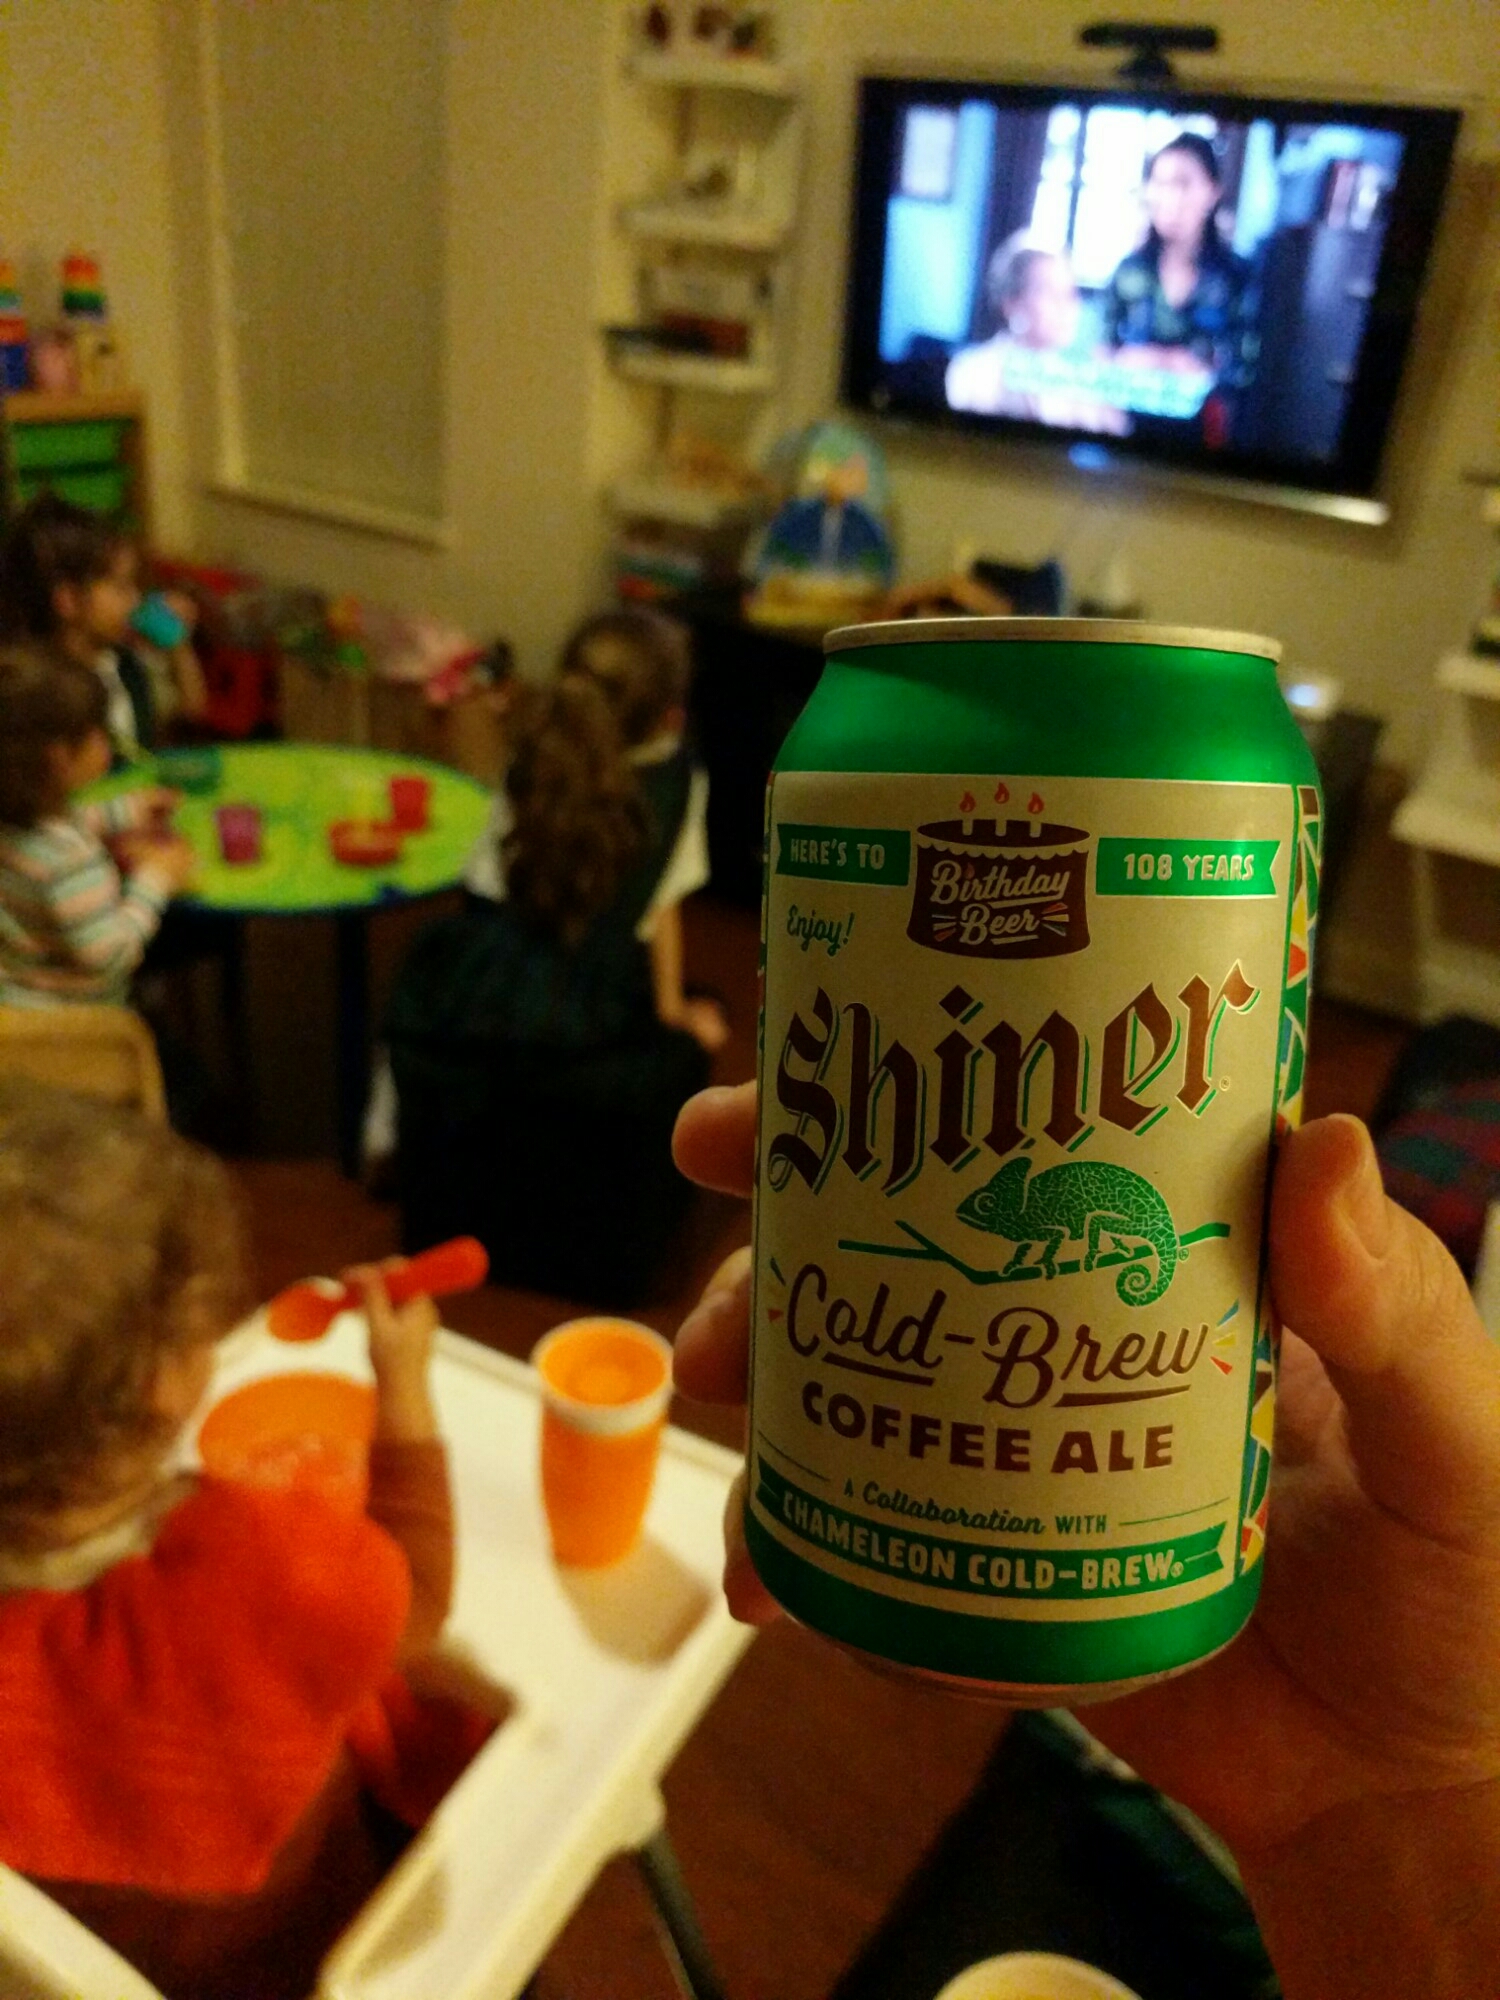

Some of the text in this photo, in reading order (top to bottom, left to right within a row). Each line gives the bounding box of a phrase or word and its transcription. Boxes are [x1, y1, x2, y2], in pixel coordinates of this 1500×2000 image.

[789, 837, 886, 871] HERE'S TO
[929, 858, 1072, 904] Birthday
[1123, 852, 1256, 882] 108 YEARS
[786, 903, 855, 957] Enjoy!
[958, 902, 1041, 945] Beer
[787, 1263, 1209, 1409] Cold-Brew
[802, 1381, 1175, 1475] COFFEE ALE
[843, 1478, 1108, 1535] A Collaboration WITH
[782, 1492, 957, 1582] CHAMELEON
